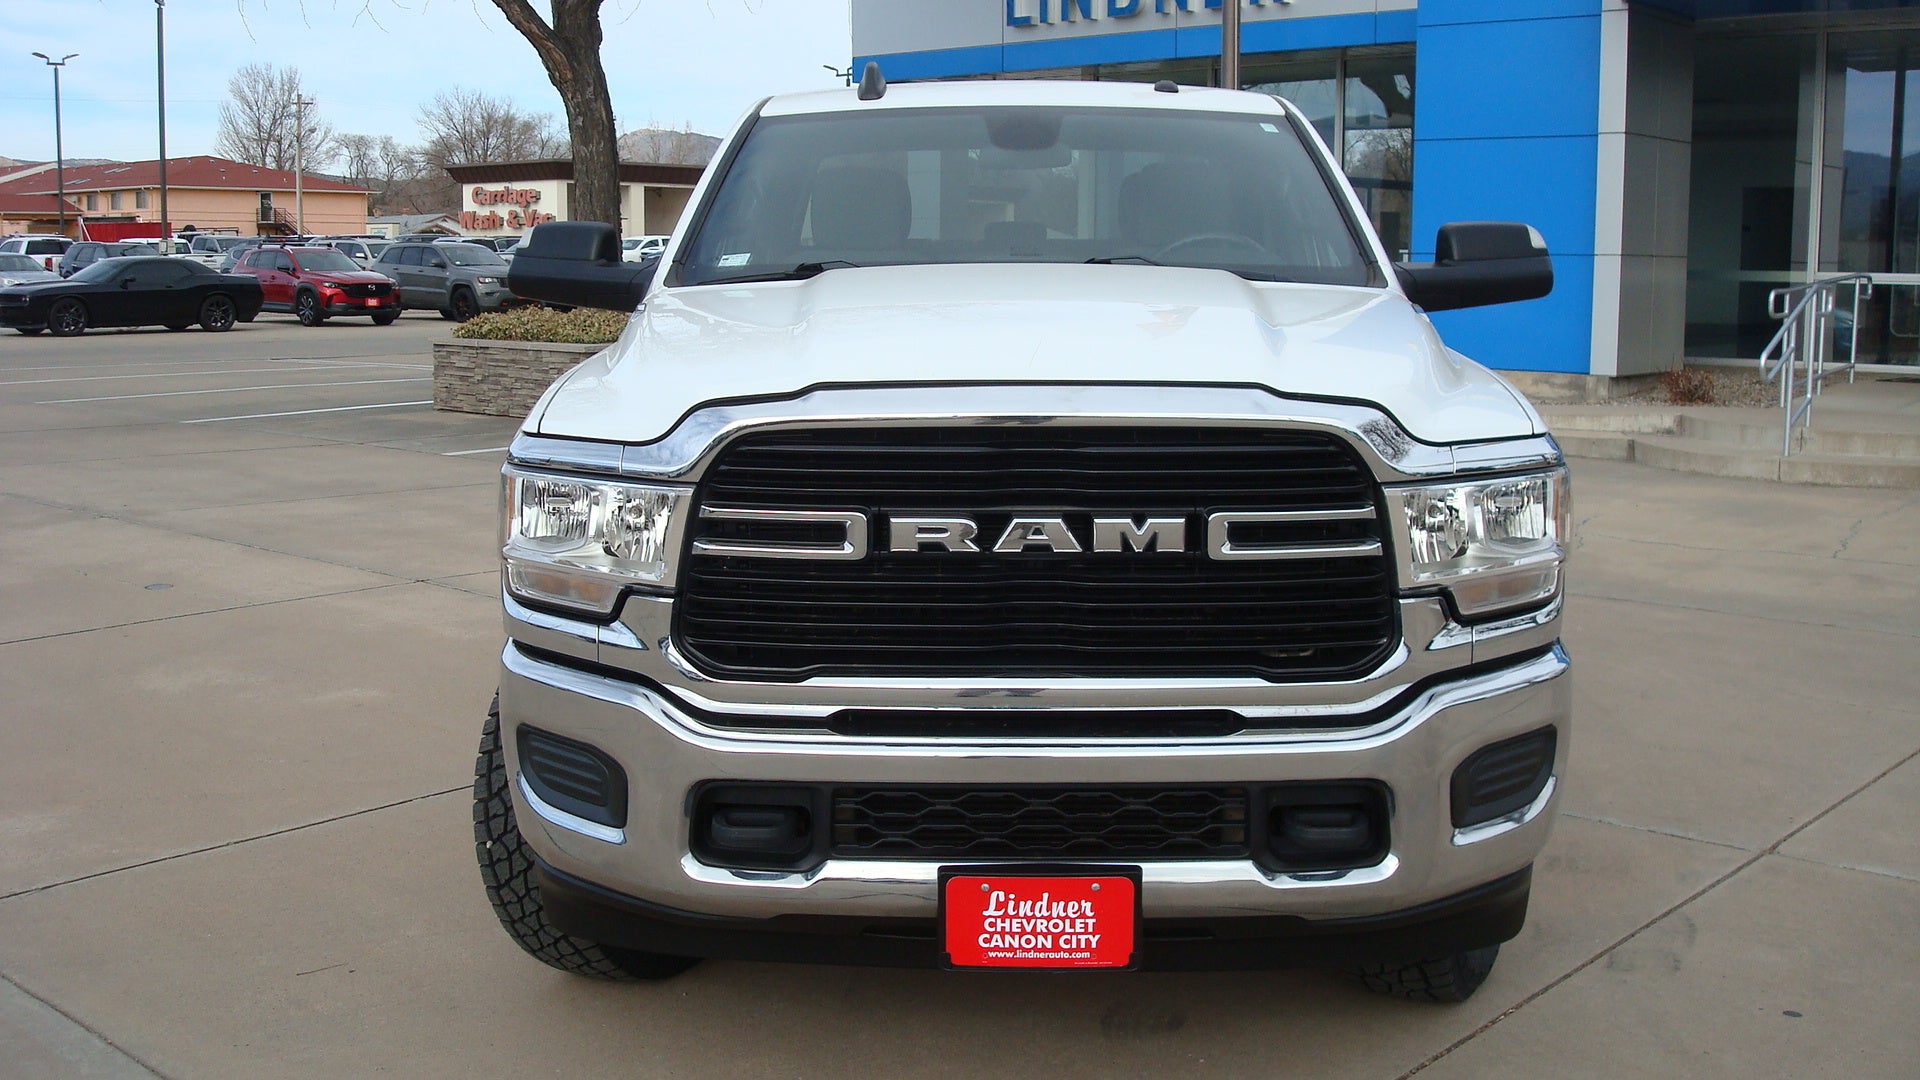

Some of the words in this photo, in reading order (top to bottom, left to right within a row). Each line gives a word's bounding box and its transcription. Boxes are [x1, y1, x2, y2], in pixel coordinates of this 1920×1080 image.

[471, 186, 538, 208] Carriage
[458, 210, 501, 229] Wash
[506, 209, 520, 229] &
[889, 517, 1187, 552] RAM
[982, 890, 1095, 918] Lindner
[983, 917, 1097, 933] CHEVROLET
[978, 934, 1053, 949] CANON
[1058, 934, 1102, 949] CITY
[987, 949, 1091, 959] www.lindnerauto.com
